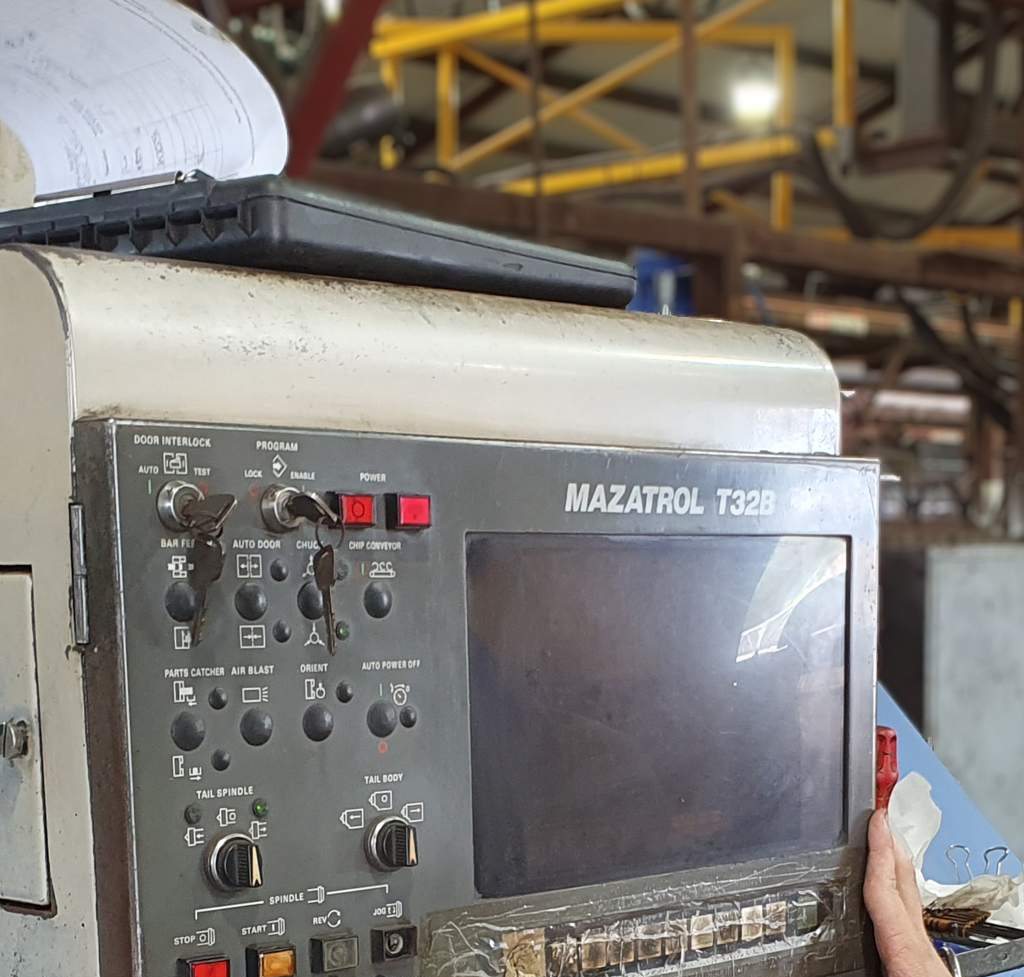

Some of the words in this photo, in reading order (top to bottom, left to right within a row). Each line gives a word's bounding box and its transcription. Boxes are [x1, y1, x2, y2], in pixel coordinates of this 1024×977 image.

[134, 435, 160, 445] DOOR
[162, 436, 211, 448] INTERLOCK
[256, 440, 298, 451] PROGRAM
[138, 465, 159, 474] AUTO
[193, 467, 211, 476] TEST
[244, 469, 262, 478] LOCK
[290, 471, 315, 480] ENABLE
[360, 473, 386, 482] POWER
[564, 483, 704, 515] MAZATROL
[716, 488, 776, 516] T32B
[160, 538, 179, 548] BAR
[232, 539, 255, 549] AUTO
[257, 539, 281, 549] DOOR
[296, 540, 324, 549] CHUC
[349, 541, 365, 550] CHIP
[366, 541, 401, 550] CONVEYOR
[300, 663, 328, 673] ORIENT
[362, 660, 379, 670] AUTO
[382, 660, 406, 669] POWER
[408, 659, 421, 668] OFF
[164, 668, 188, 678] PARTS
[191, 667, 225, 677] CATCHER
[231, 666, 247, 675] AIR
[248, 665, 274, 675] BLAST
[364, 775, 381, 784] TAIL
[383, 773, 403, 783] BODY
[196, 789, 215, 800] TAIL
[217, 786, 254, 798] SPINDLE
[269, 892, 304, 905] SPINDLE
[373, 907, 387, 917] JOG
[313, 916, 327, 925] REV
[241, 924, 267, 936] START
[174, 935, 195, 946] STOP
